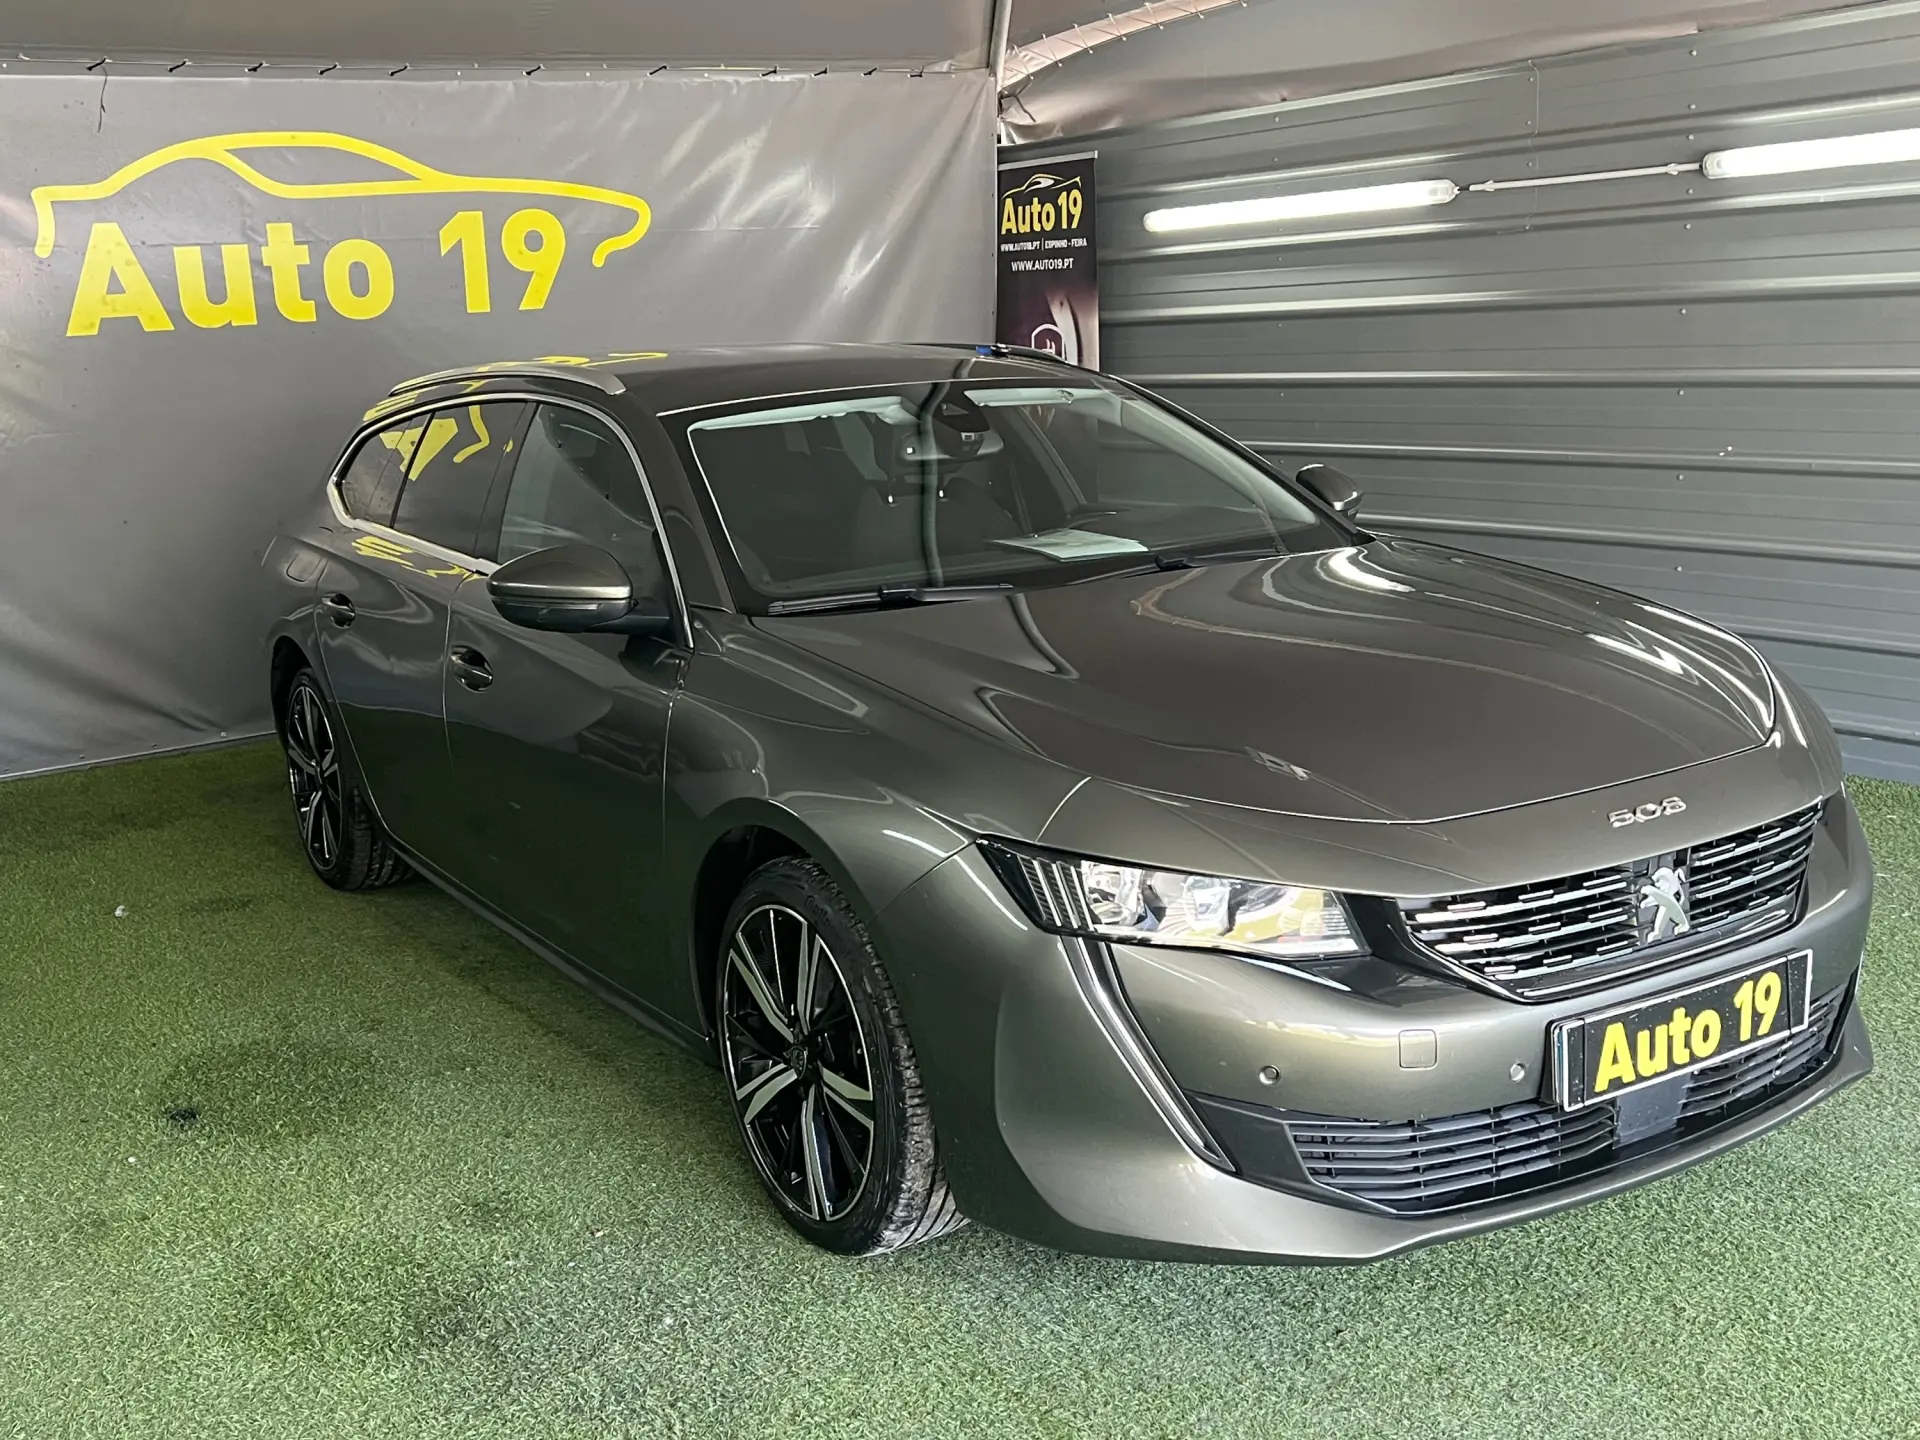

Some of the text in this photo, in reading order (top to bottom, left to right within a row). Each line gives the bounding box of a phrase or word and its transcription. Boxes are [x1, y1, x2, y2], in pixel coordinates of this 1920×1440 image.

[1001, 189, 1082, 234] Auto 19
[1071, 238, 1087, 247] FEIRA
[65, 208, 566, 337] Auto 19
[1011, 258, 1073, 271] WWW.AUTO19.PT
[1607, 796, 1687, 828] 508
[1593, 971, 1782, 1093] Auto 19
